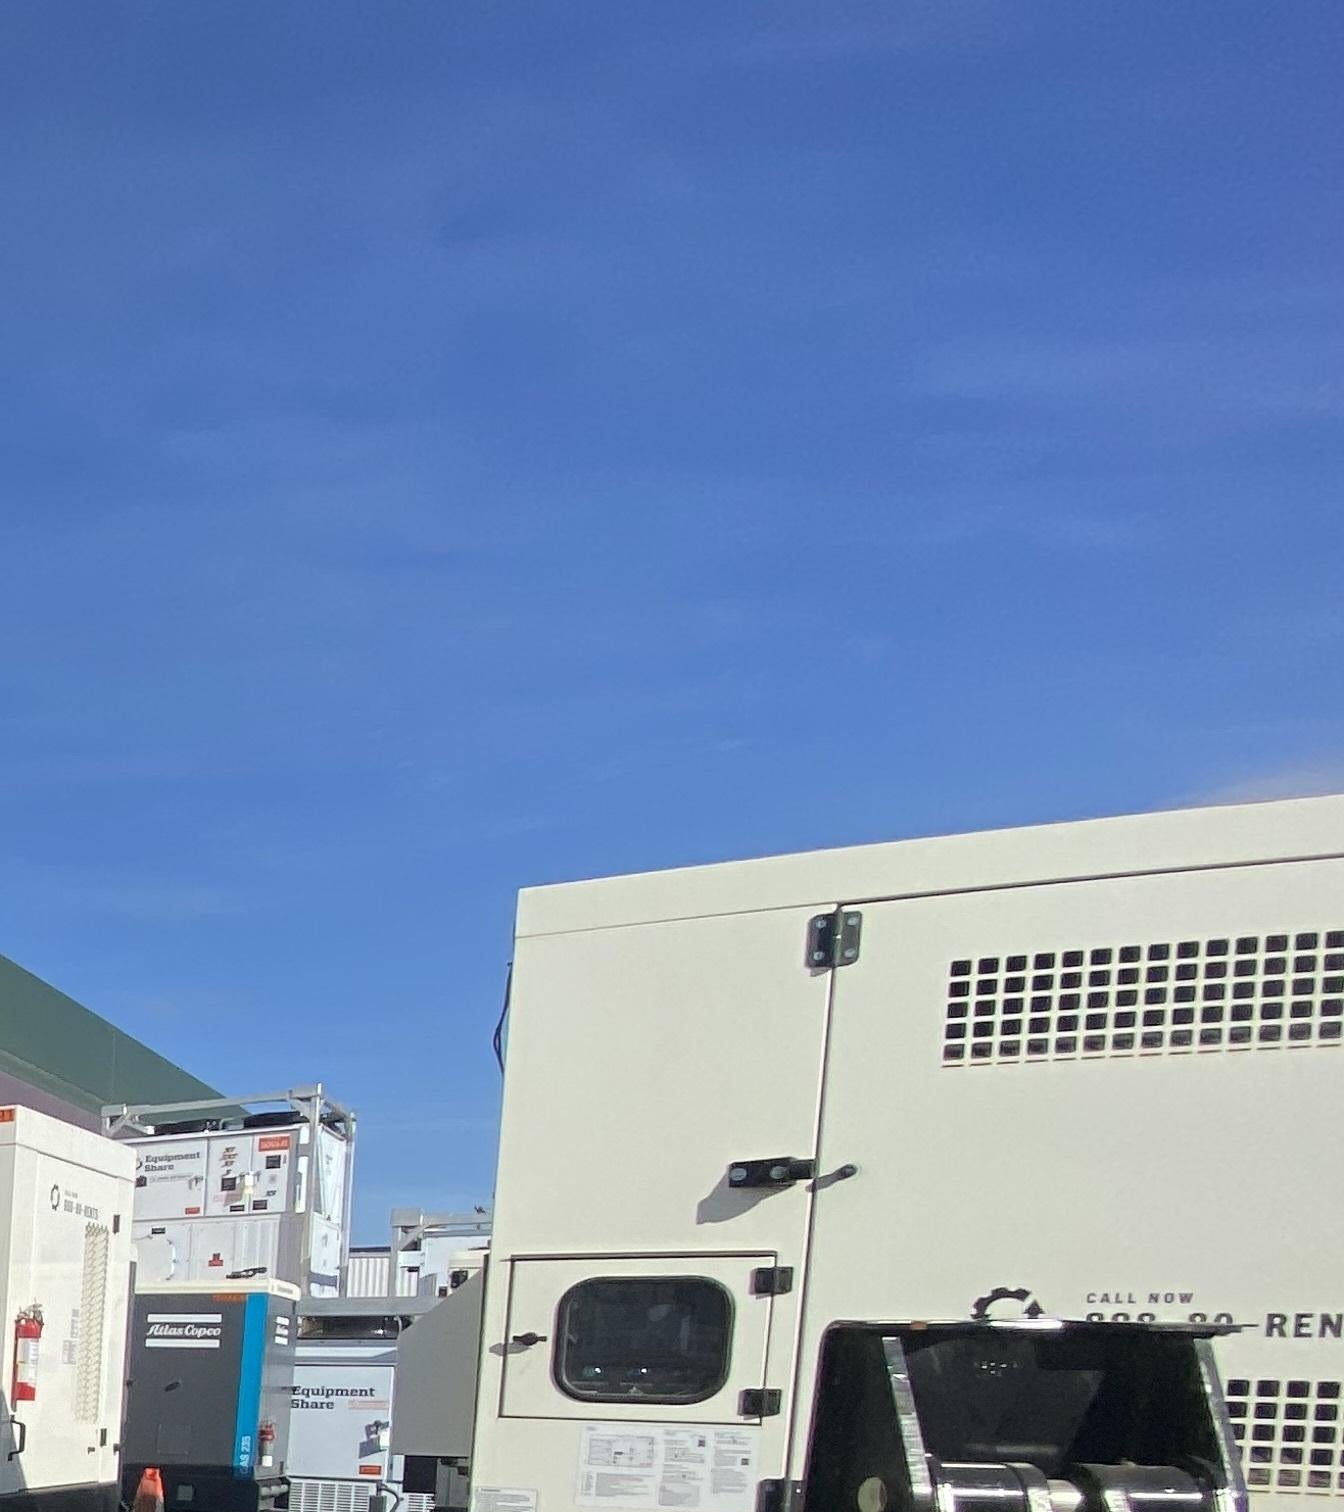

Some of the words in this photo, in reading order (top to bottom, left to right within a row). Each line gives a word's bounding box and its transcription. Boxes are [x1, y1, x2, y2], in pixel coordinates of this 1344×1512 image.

[145, 1151, 201, 1163] Equipment
[144, 1164, 175, 1172] Share
[1086, 1292, 1137, 1305] CALL
[1147, 1292, 1195, 1305] NOW
[146, 1324, 184, 1337] Atlas
[184, 1323, 222, 1338] Copco
[292, 1385, 376, 1399] Equipment
[291, 1398, 335, 1410] Share
